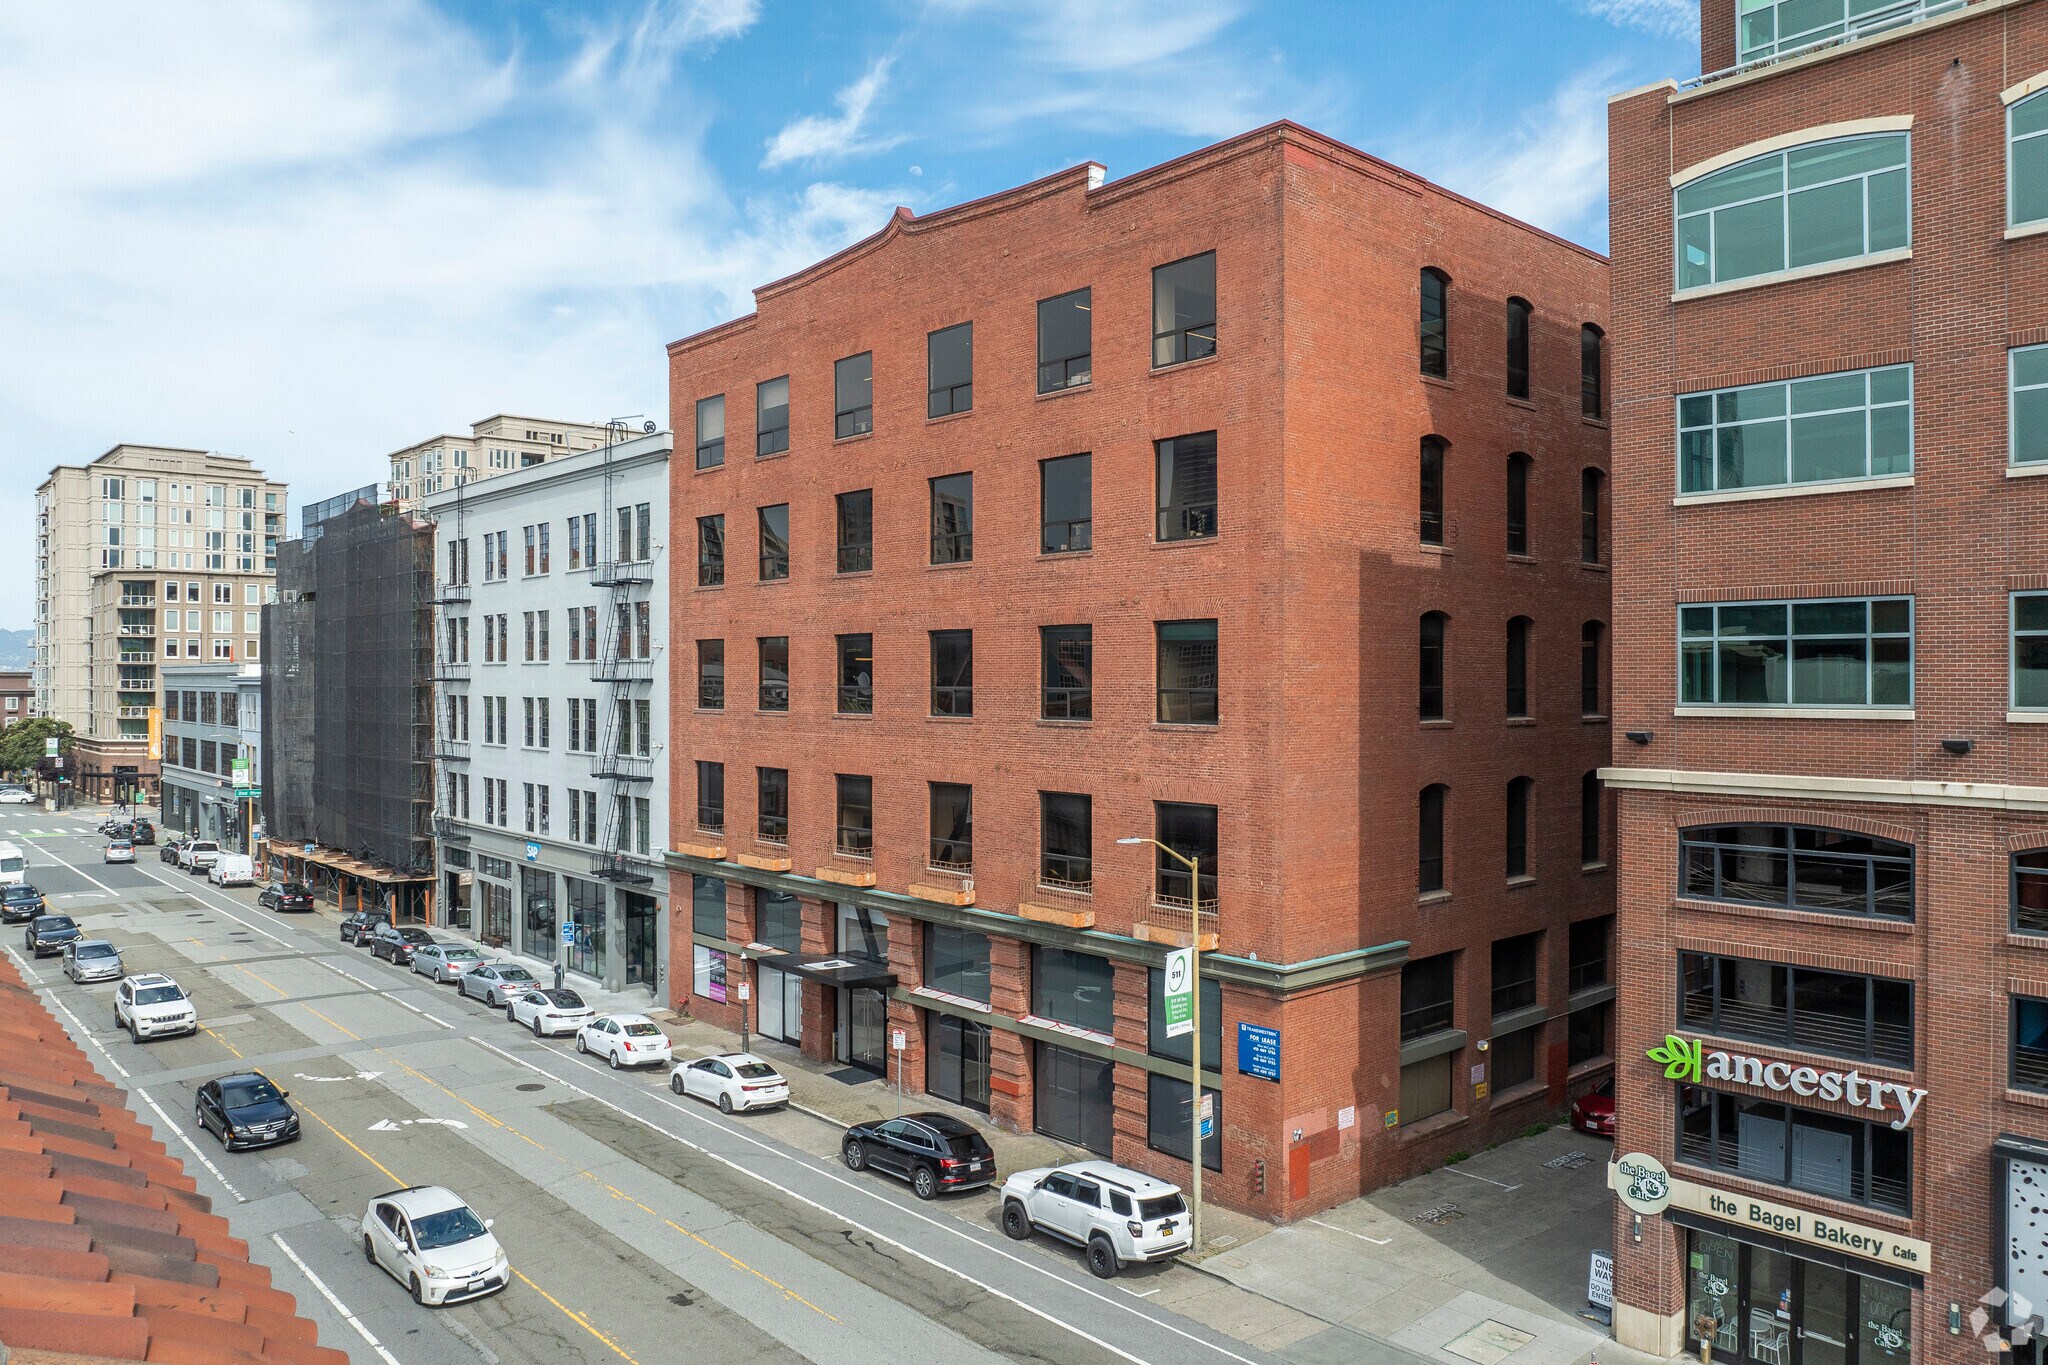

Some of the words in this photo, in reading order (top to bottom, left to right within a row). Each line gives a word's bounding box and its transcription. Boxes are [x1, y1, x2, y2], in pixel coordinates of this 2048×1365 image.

[527, 845, 538, 858] SAP
[1172, 970, 1181, 979] 511
[1250, 1034, 1259, 1042] FOR
[1262, 1037, 1276, 1045] LEASE
[1706, 1051, 1928, 1130] ancestry
[1620, 1162, 1635, 1175] the
[1638, 1166, 1665, 1183] Bagel
[1710, 1194, 1737, 1216] the
[1750, 1204, 1801, 1232] Bagel
[1814, 1220, 1883, 1256] Bakery
[1893, 1245, 1917, 1261] Cafe
[1699, 1242, 1732, 1260] OPEN
[1596, 1259, 1613, 1272] ONE
[1595, 1269, 1613, 1282] WAY
[1591, 1283, 1600, 1291] DO
[1602, 1287, 1611, 1295] NO
[1592, 1291, 1612, 1303] ENTER
[1868, 1320, 1879, 1330] the
